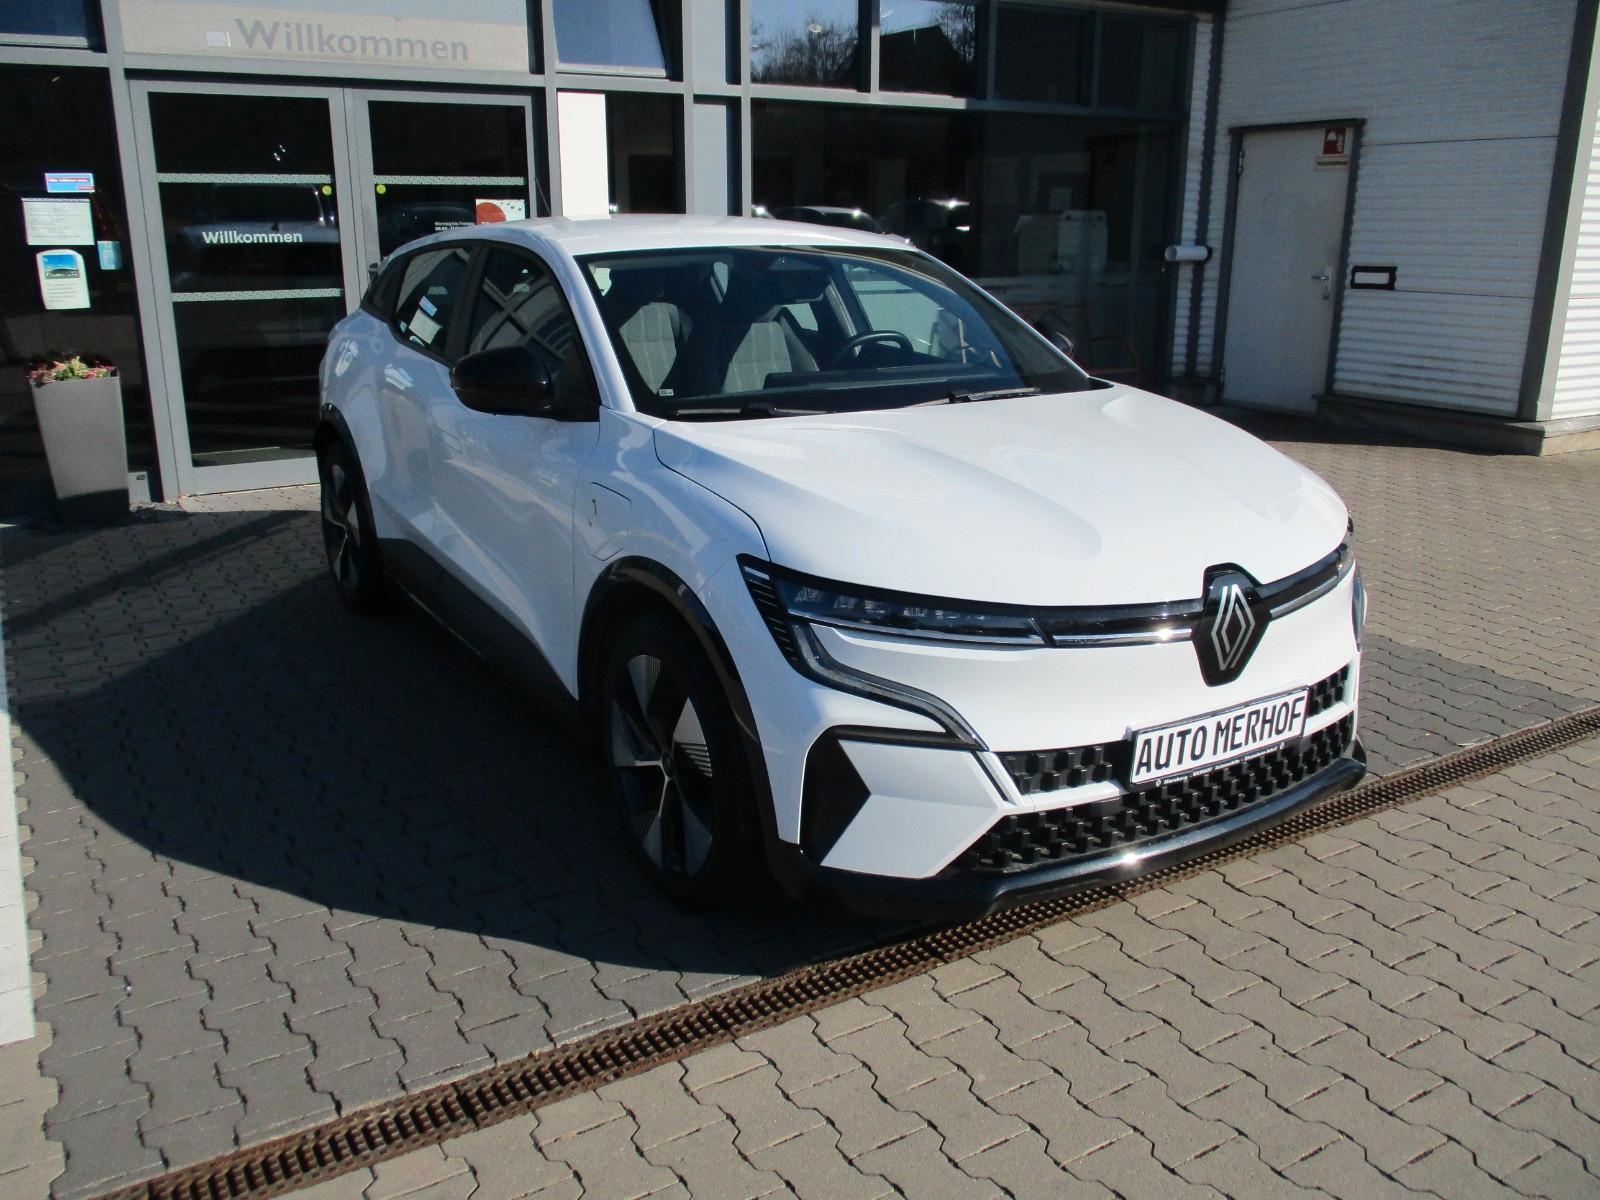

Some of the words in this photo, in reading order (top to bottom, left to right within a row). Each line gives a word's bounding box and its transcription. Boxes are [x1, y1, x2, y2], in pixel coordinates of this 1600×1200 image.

[235, 18, 468, 61] Willkommen
[202, 231, 303, 243] Willkommen
[1135, 725, 1207, 776] AUTO
[1212, 696, 1305, 755] MERHOF
